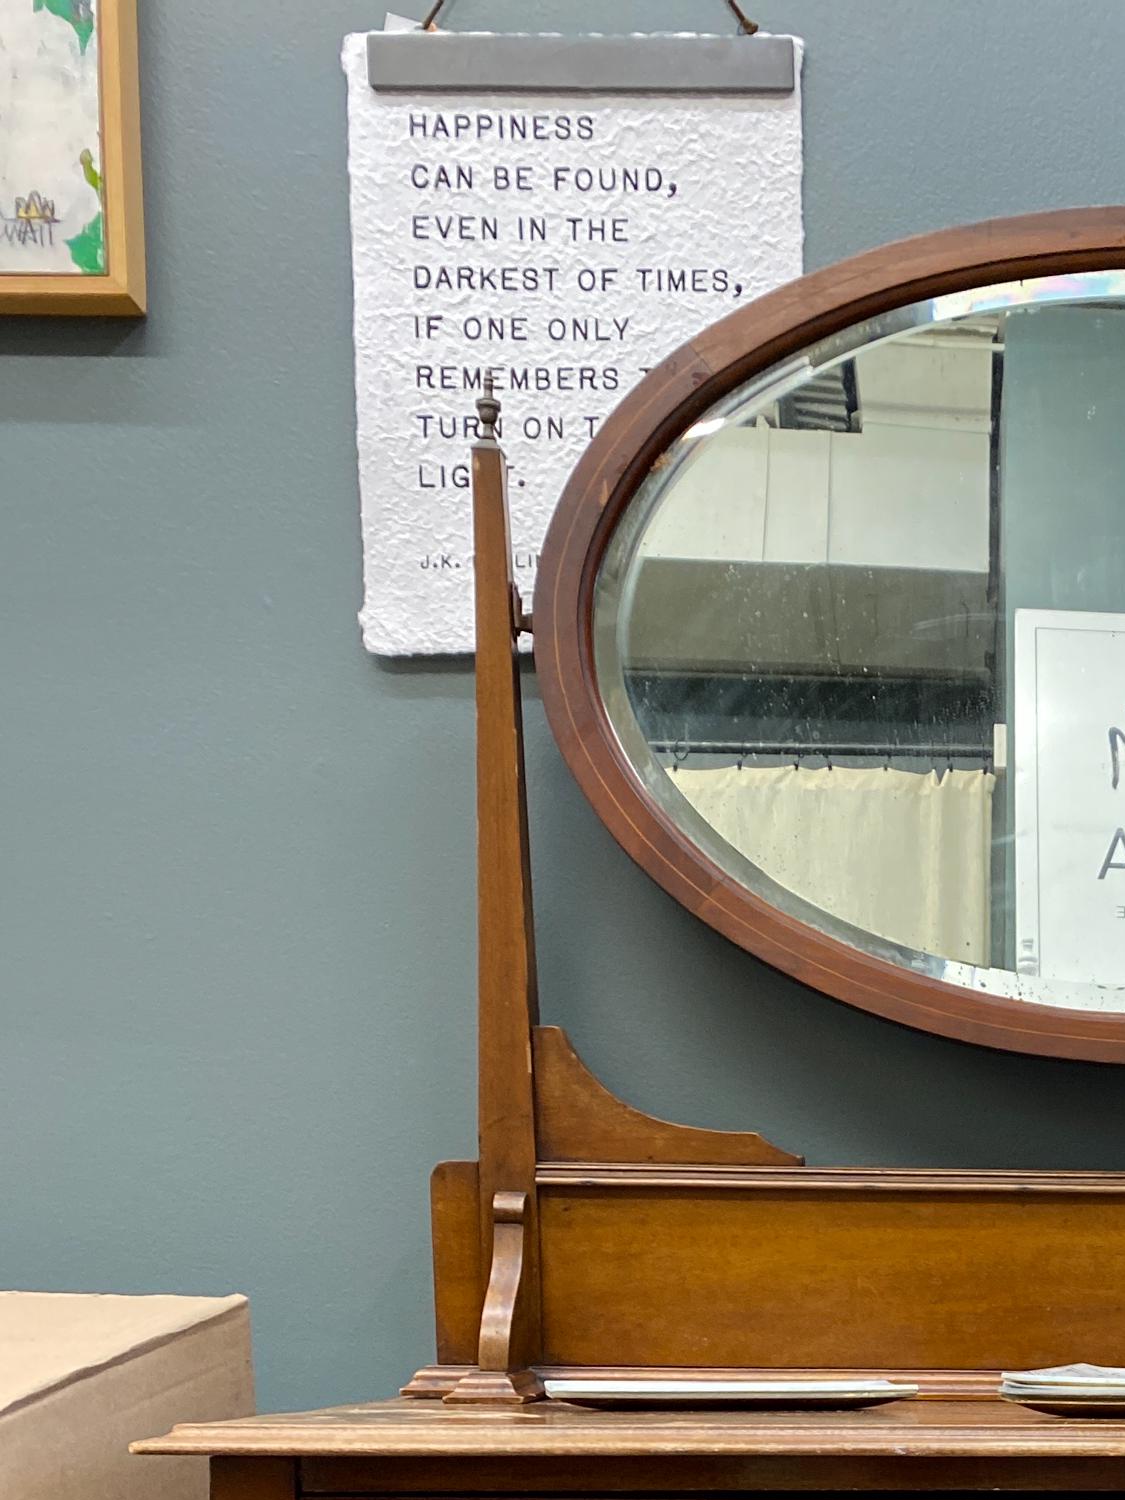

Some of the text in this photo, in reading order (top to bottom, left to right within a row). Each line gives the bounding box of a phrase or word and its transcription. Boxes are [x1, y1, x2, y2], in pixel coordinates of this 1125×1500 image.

[408, 112, 595, 141] HAPPINESS
[410, 163, 678, 198] CAN BE FOUND,
[412, 215, 629, 242] EVEN IN THE
[413, 265, 743, 298] DARKEST OF TIMES,
[413, 315, 630, 341] IF ONE ONLY
[416, 365, 620, 391] REMEMBERS
[522, 416, 564, 440] ON
[418, 464, 526, 489] LIG.
[419, 554, 461, 569] J.K.
